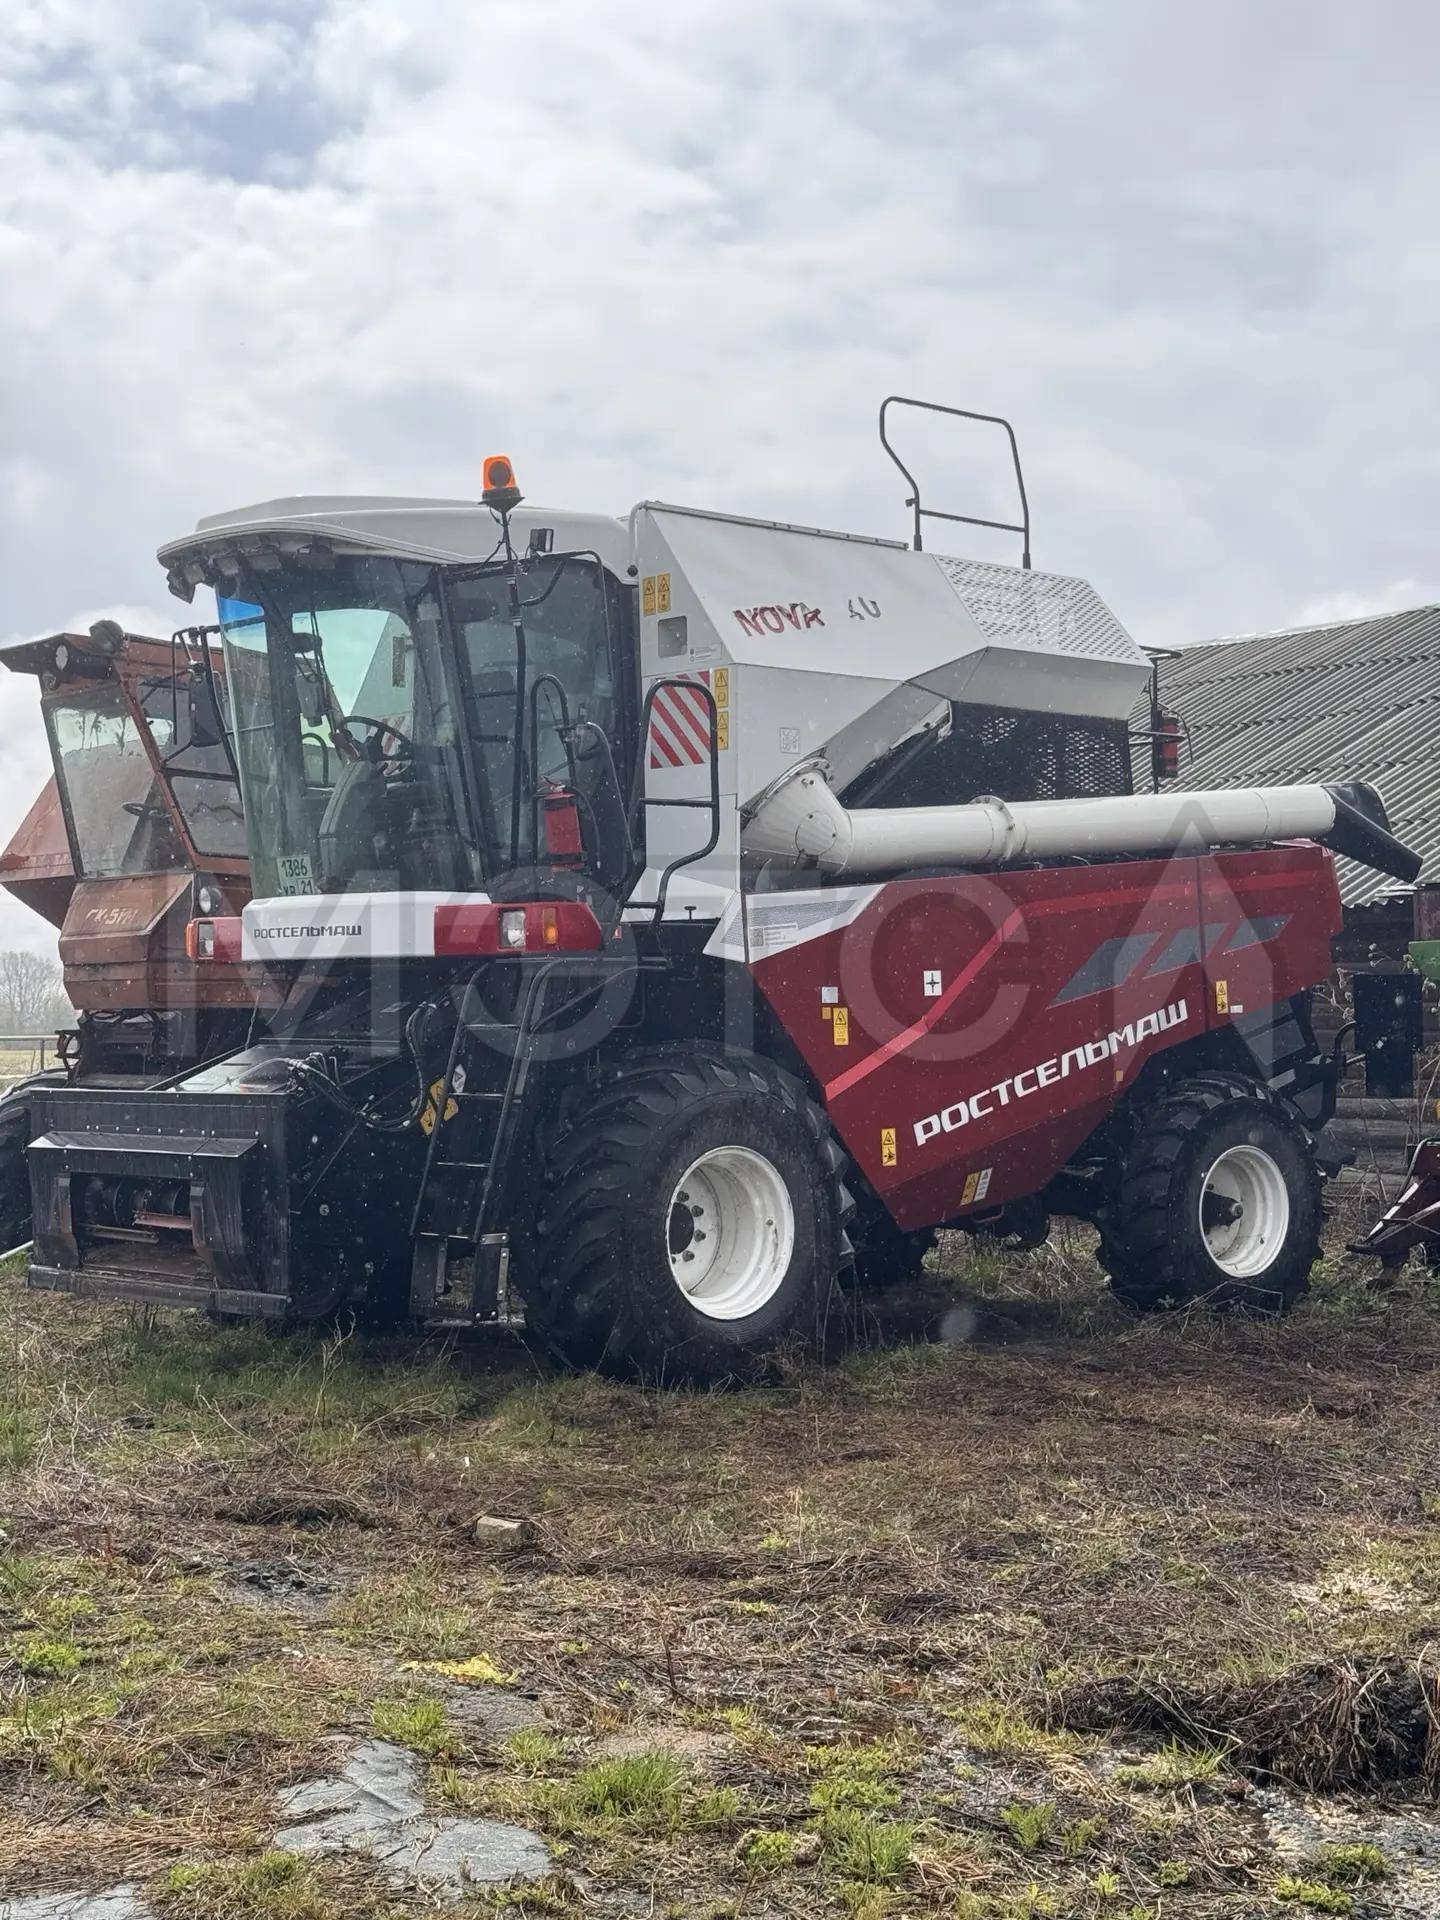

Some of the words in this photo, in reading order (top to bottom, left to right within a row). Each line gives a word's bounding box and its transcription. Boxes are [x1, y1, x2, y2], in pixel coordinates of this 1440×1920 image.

[281, 858, 308, 877] 1386
[301, 879, 314, 895] 21
[254, 924, 362, 939] РОСТСЕЛЬМАШ
[913, 998, 1189, 1147] РОСТСЕЛЬМАШ
